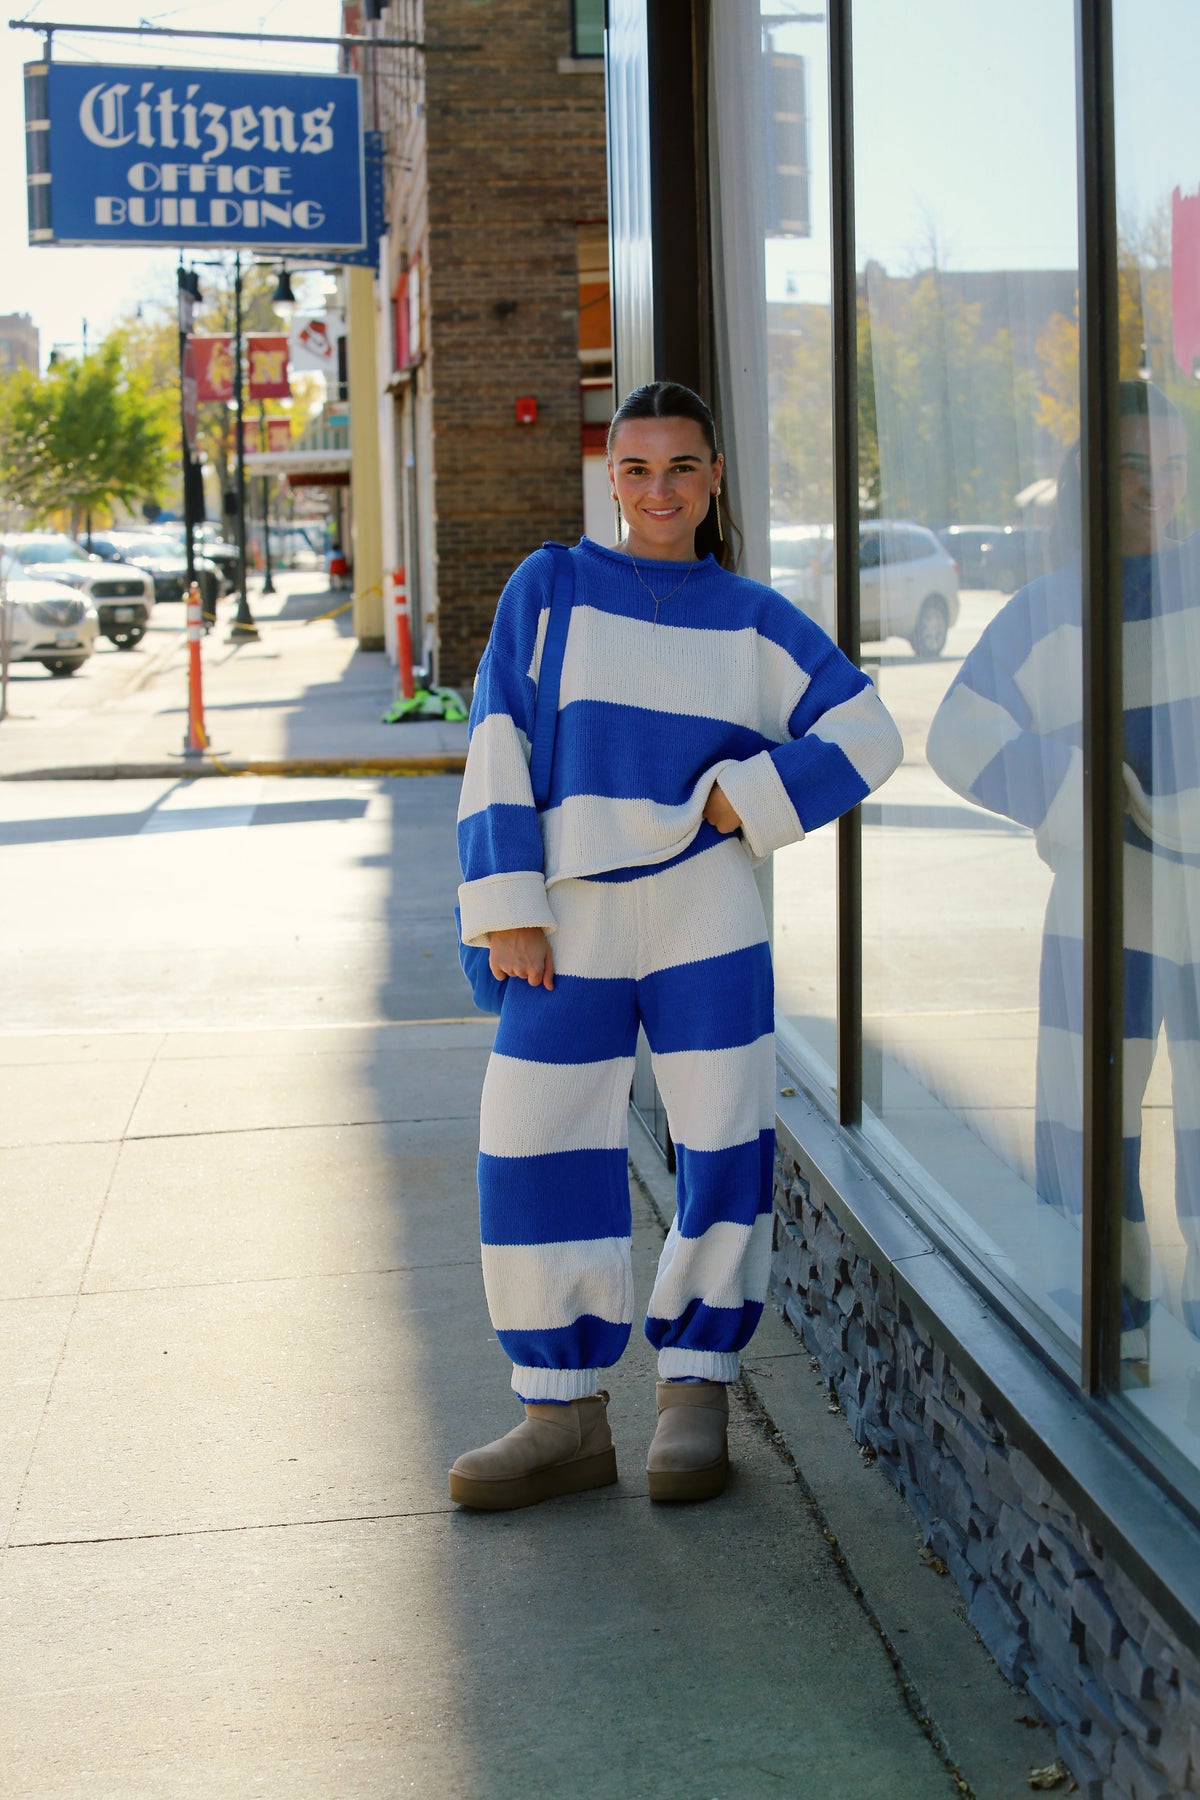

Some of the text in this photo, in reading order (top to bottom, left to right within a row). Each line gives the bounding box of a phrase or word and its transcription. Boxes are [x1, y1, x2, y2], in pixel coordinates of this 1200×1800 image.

[79, 82, 335, 161] Citizens
[127, 162, 292, 194] OFFICE
[95, 197, 325, 229] BUILDING
[251, 351, 285, 384] N
